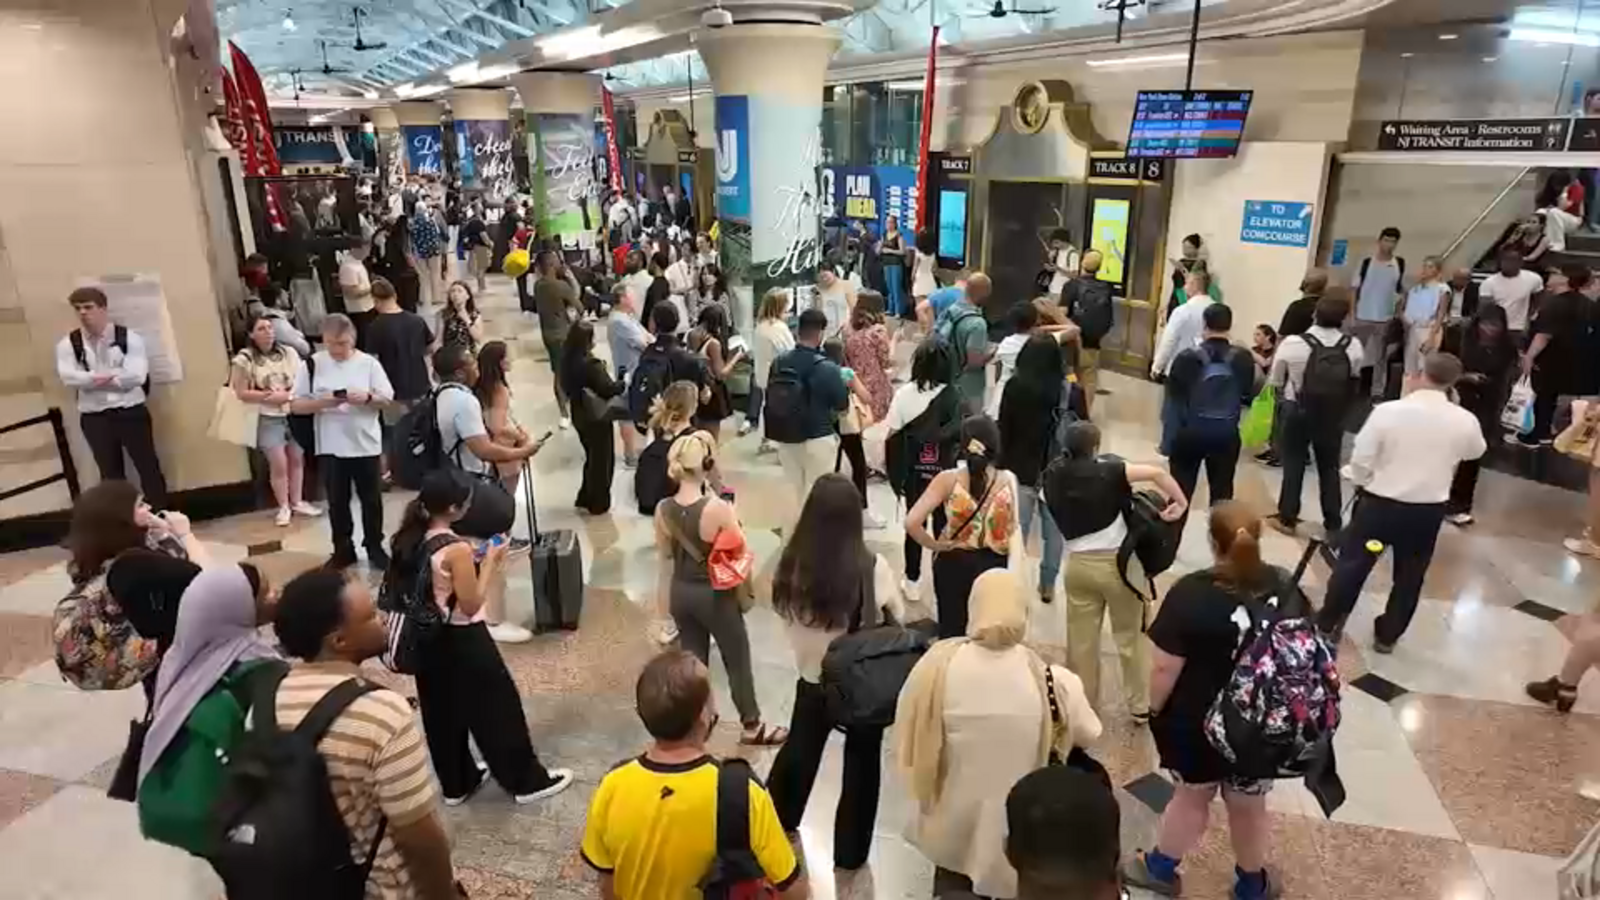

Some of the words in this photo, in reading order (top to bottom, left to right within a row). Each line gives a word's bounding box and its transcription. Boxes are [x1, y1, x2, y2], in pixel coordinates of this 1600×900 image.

[1400, 124, 1441, 137] Waiting
[1441, 124, 1469, 135] Area
[1478, 123, 1542, 135] Restrooms
[1396, 136, 1411, 149] NJ
[1411, 136, 1463, 148] TRANSIT
[1463, 137, 1533, 148] Information
[941, 160, 963, 169] TRACK
[963, 160, 969, 170] 7
[1095, 162, 1128, 174] TRACK
[1129, 162, 1136, 174] 8
[1147, 161, 1159, 178] 8
[1271, 204, 1285, 215] TO
[1249, 216, 1303, 229] ELEVATOR
[1242, 229, 1307, 243] CONCOURSE
